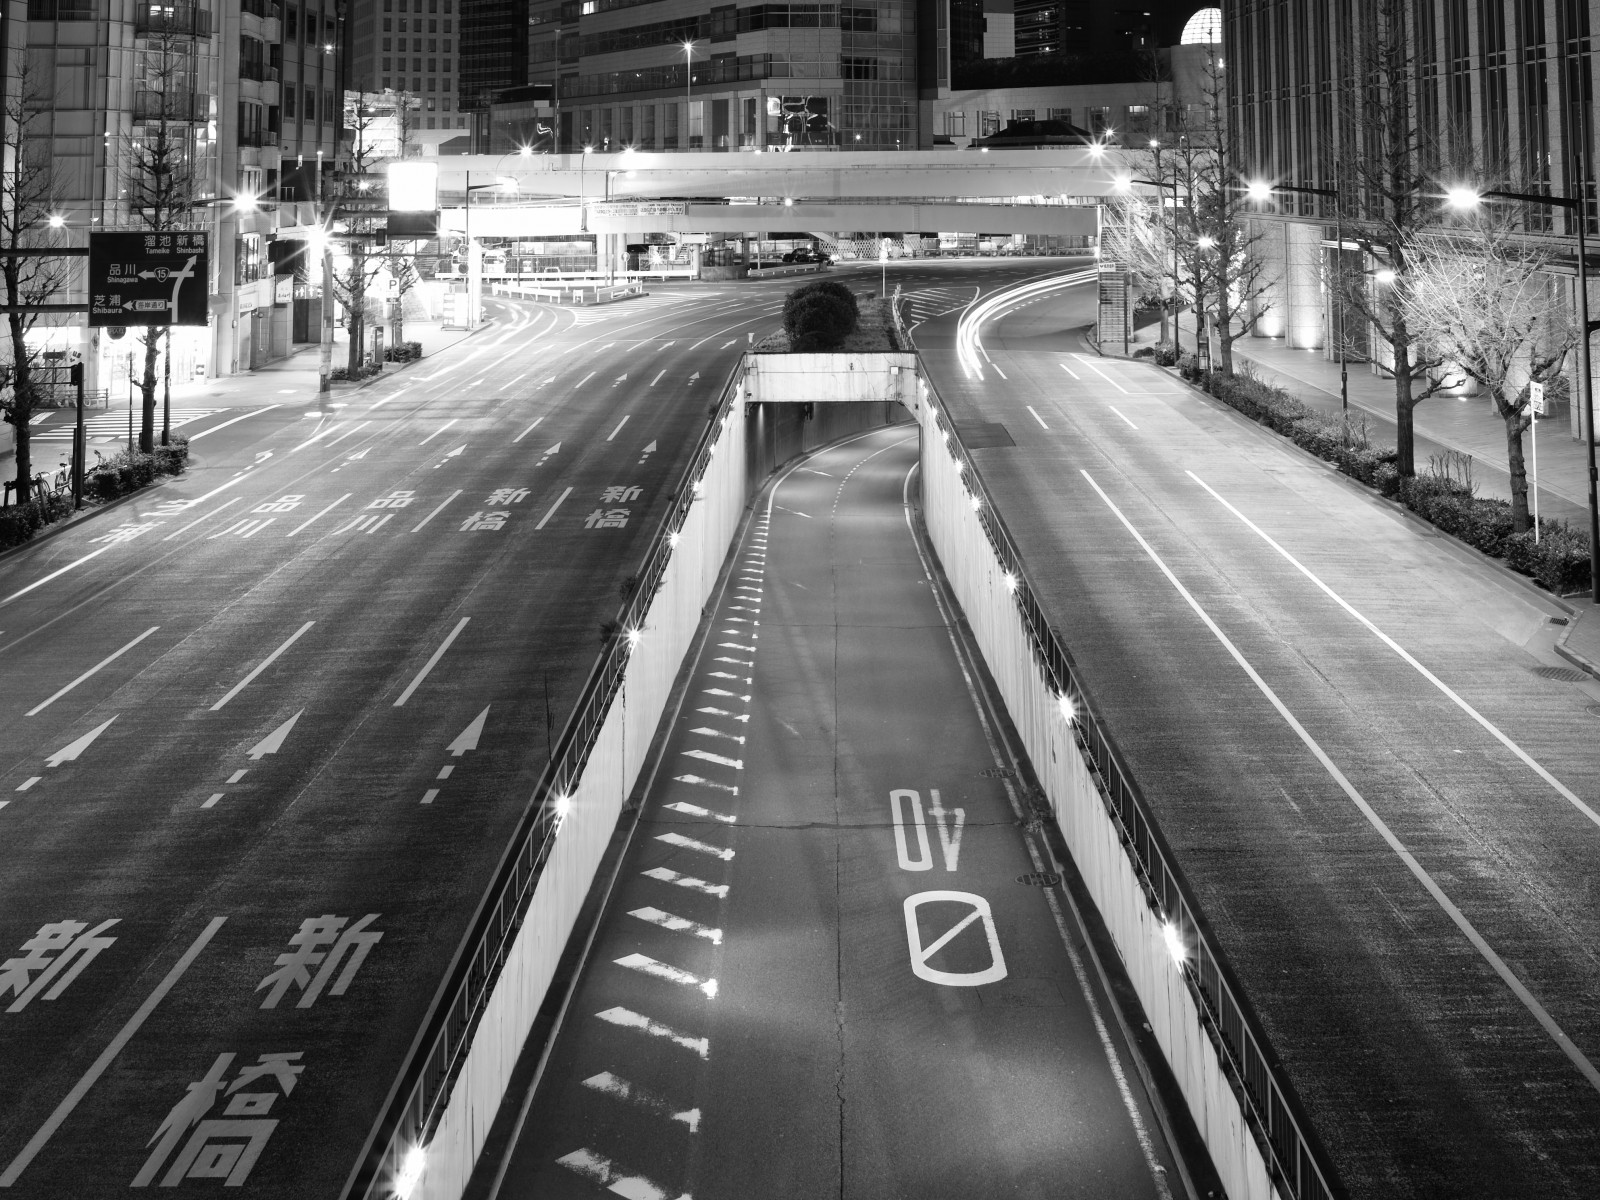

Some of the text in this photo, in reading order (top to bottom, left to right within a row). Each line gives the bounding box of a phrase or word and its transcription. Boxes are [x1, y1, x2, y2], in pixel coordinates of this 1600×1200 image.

[144, 234, 205, 247] 溜池 新橋
[109, 263, 136, 276] 品川
[157, 269, 167, 279] 15
[107, 276, 139, 284] Shinagawa
[389, 279, 397, 290] P
[93, 294, 121, 307] 芝浦
[331, 490, 416, 535] 品川
[458, 487, 532, 532] 新橋
[584, 485, 644, 529] 新橋
[206, 494, 306, 540] 品川
[129, 913, 385, 1188] 新橋
